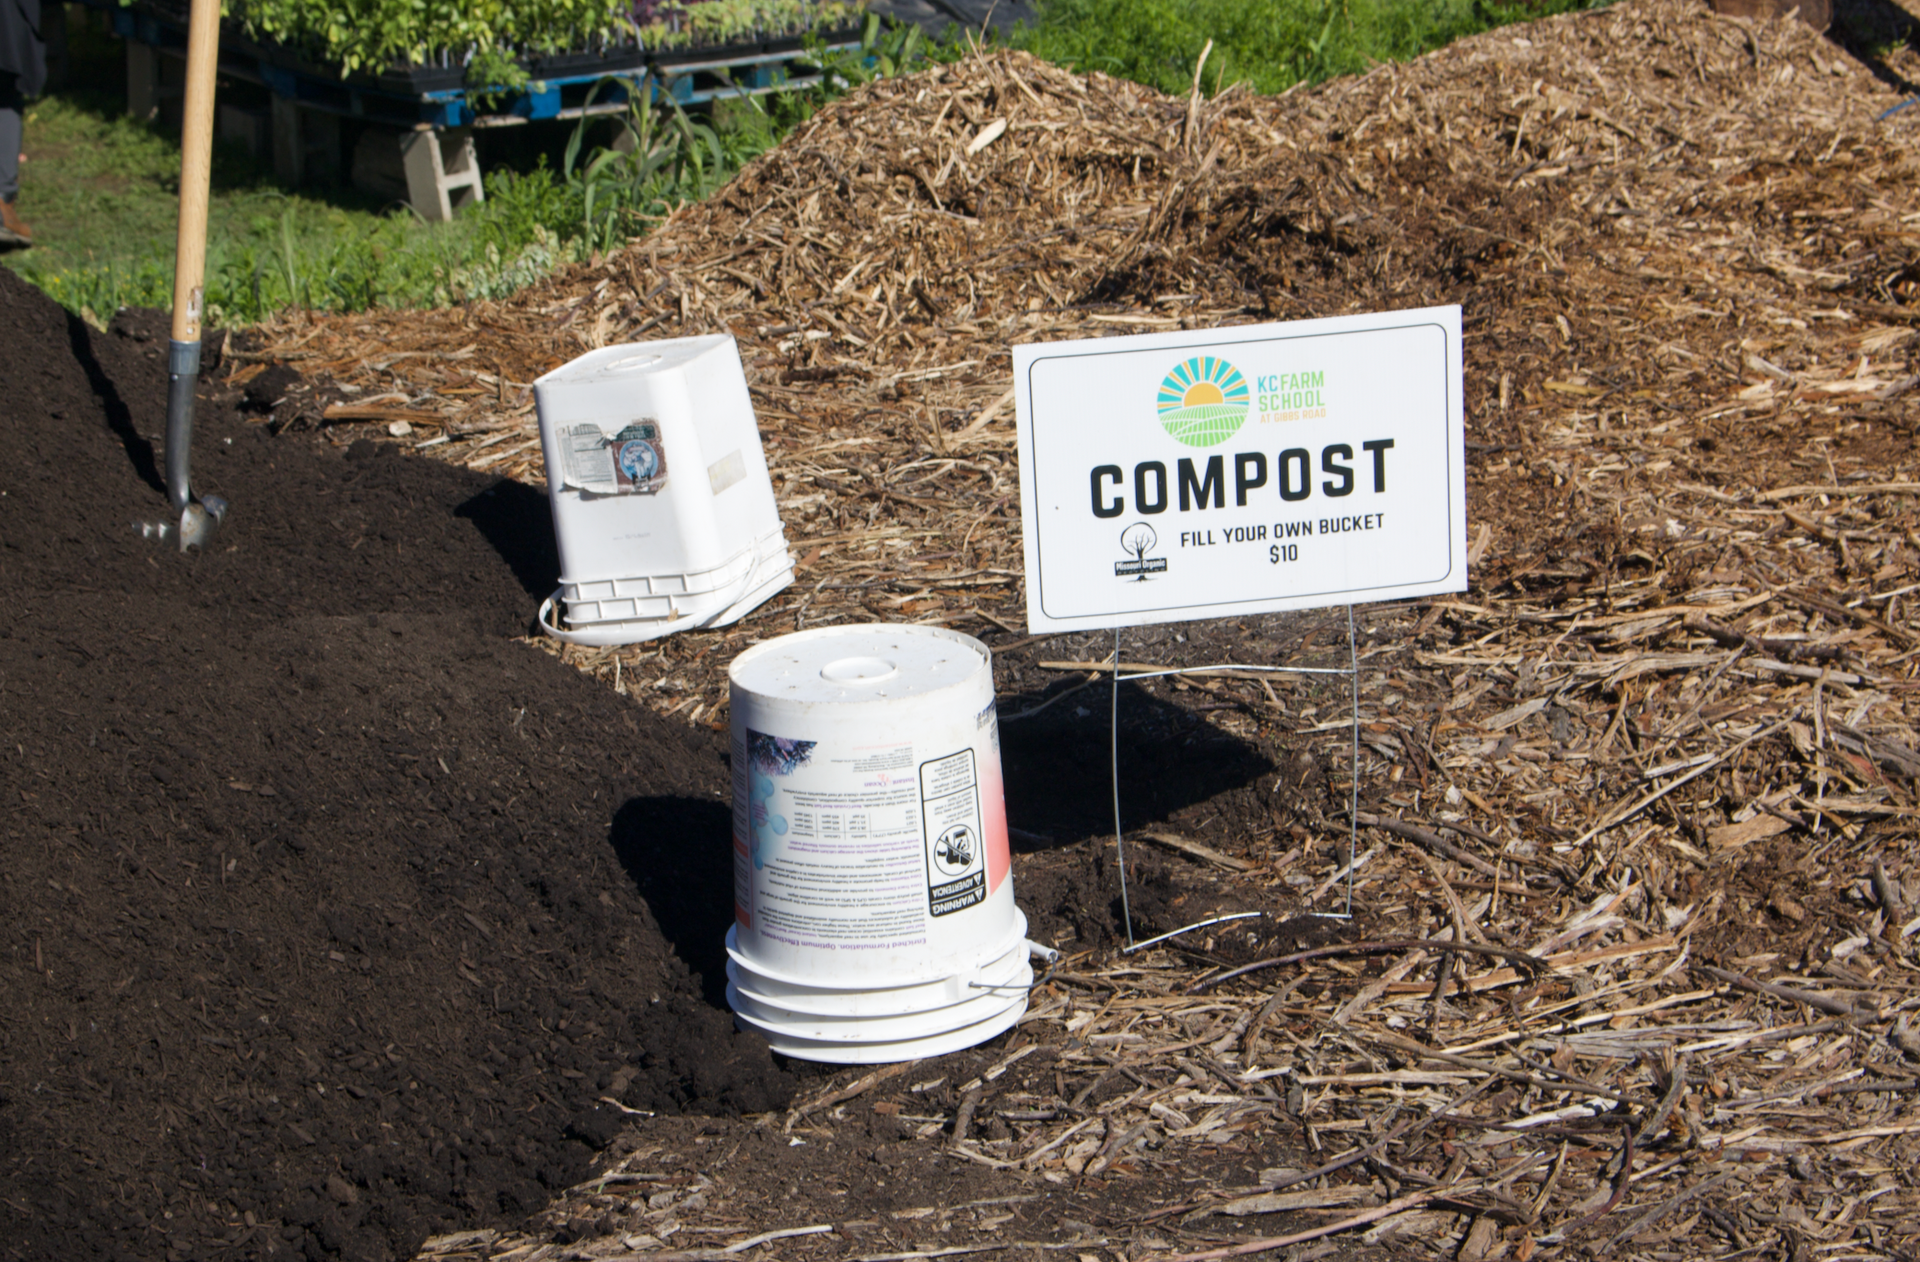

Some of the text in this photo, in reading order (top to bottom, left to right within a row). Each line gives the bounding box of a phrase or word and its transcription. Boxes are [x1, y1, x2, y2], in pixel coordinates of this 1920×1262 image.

[1258, 390, 1326, 412] SCHOOL
[1260, 408, 1327, 424] AT GIBBS ROAD
[1090, 438, 1395, 518] COMPOST
[1181, 513, 1385, 548] FILL YOUR OWN BUCKET
[1270, 544, 1298, 564] $10
[1116, 560, 1141, 572] Missouri
[1143, 558, 1166, 570] Organic
[892, 777, 915, 786] Instant
[932, 878, 974, 898] ADVERTENCIA
[932, 894, 976, 914] WARNING
[801, 941, 836, 950] Optimum
[892, 938, 926, 948] Enriched
